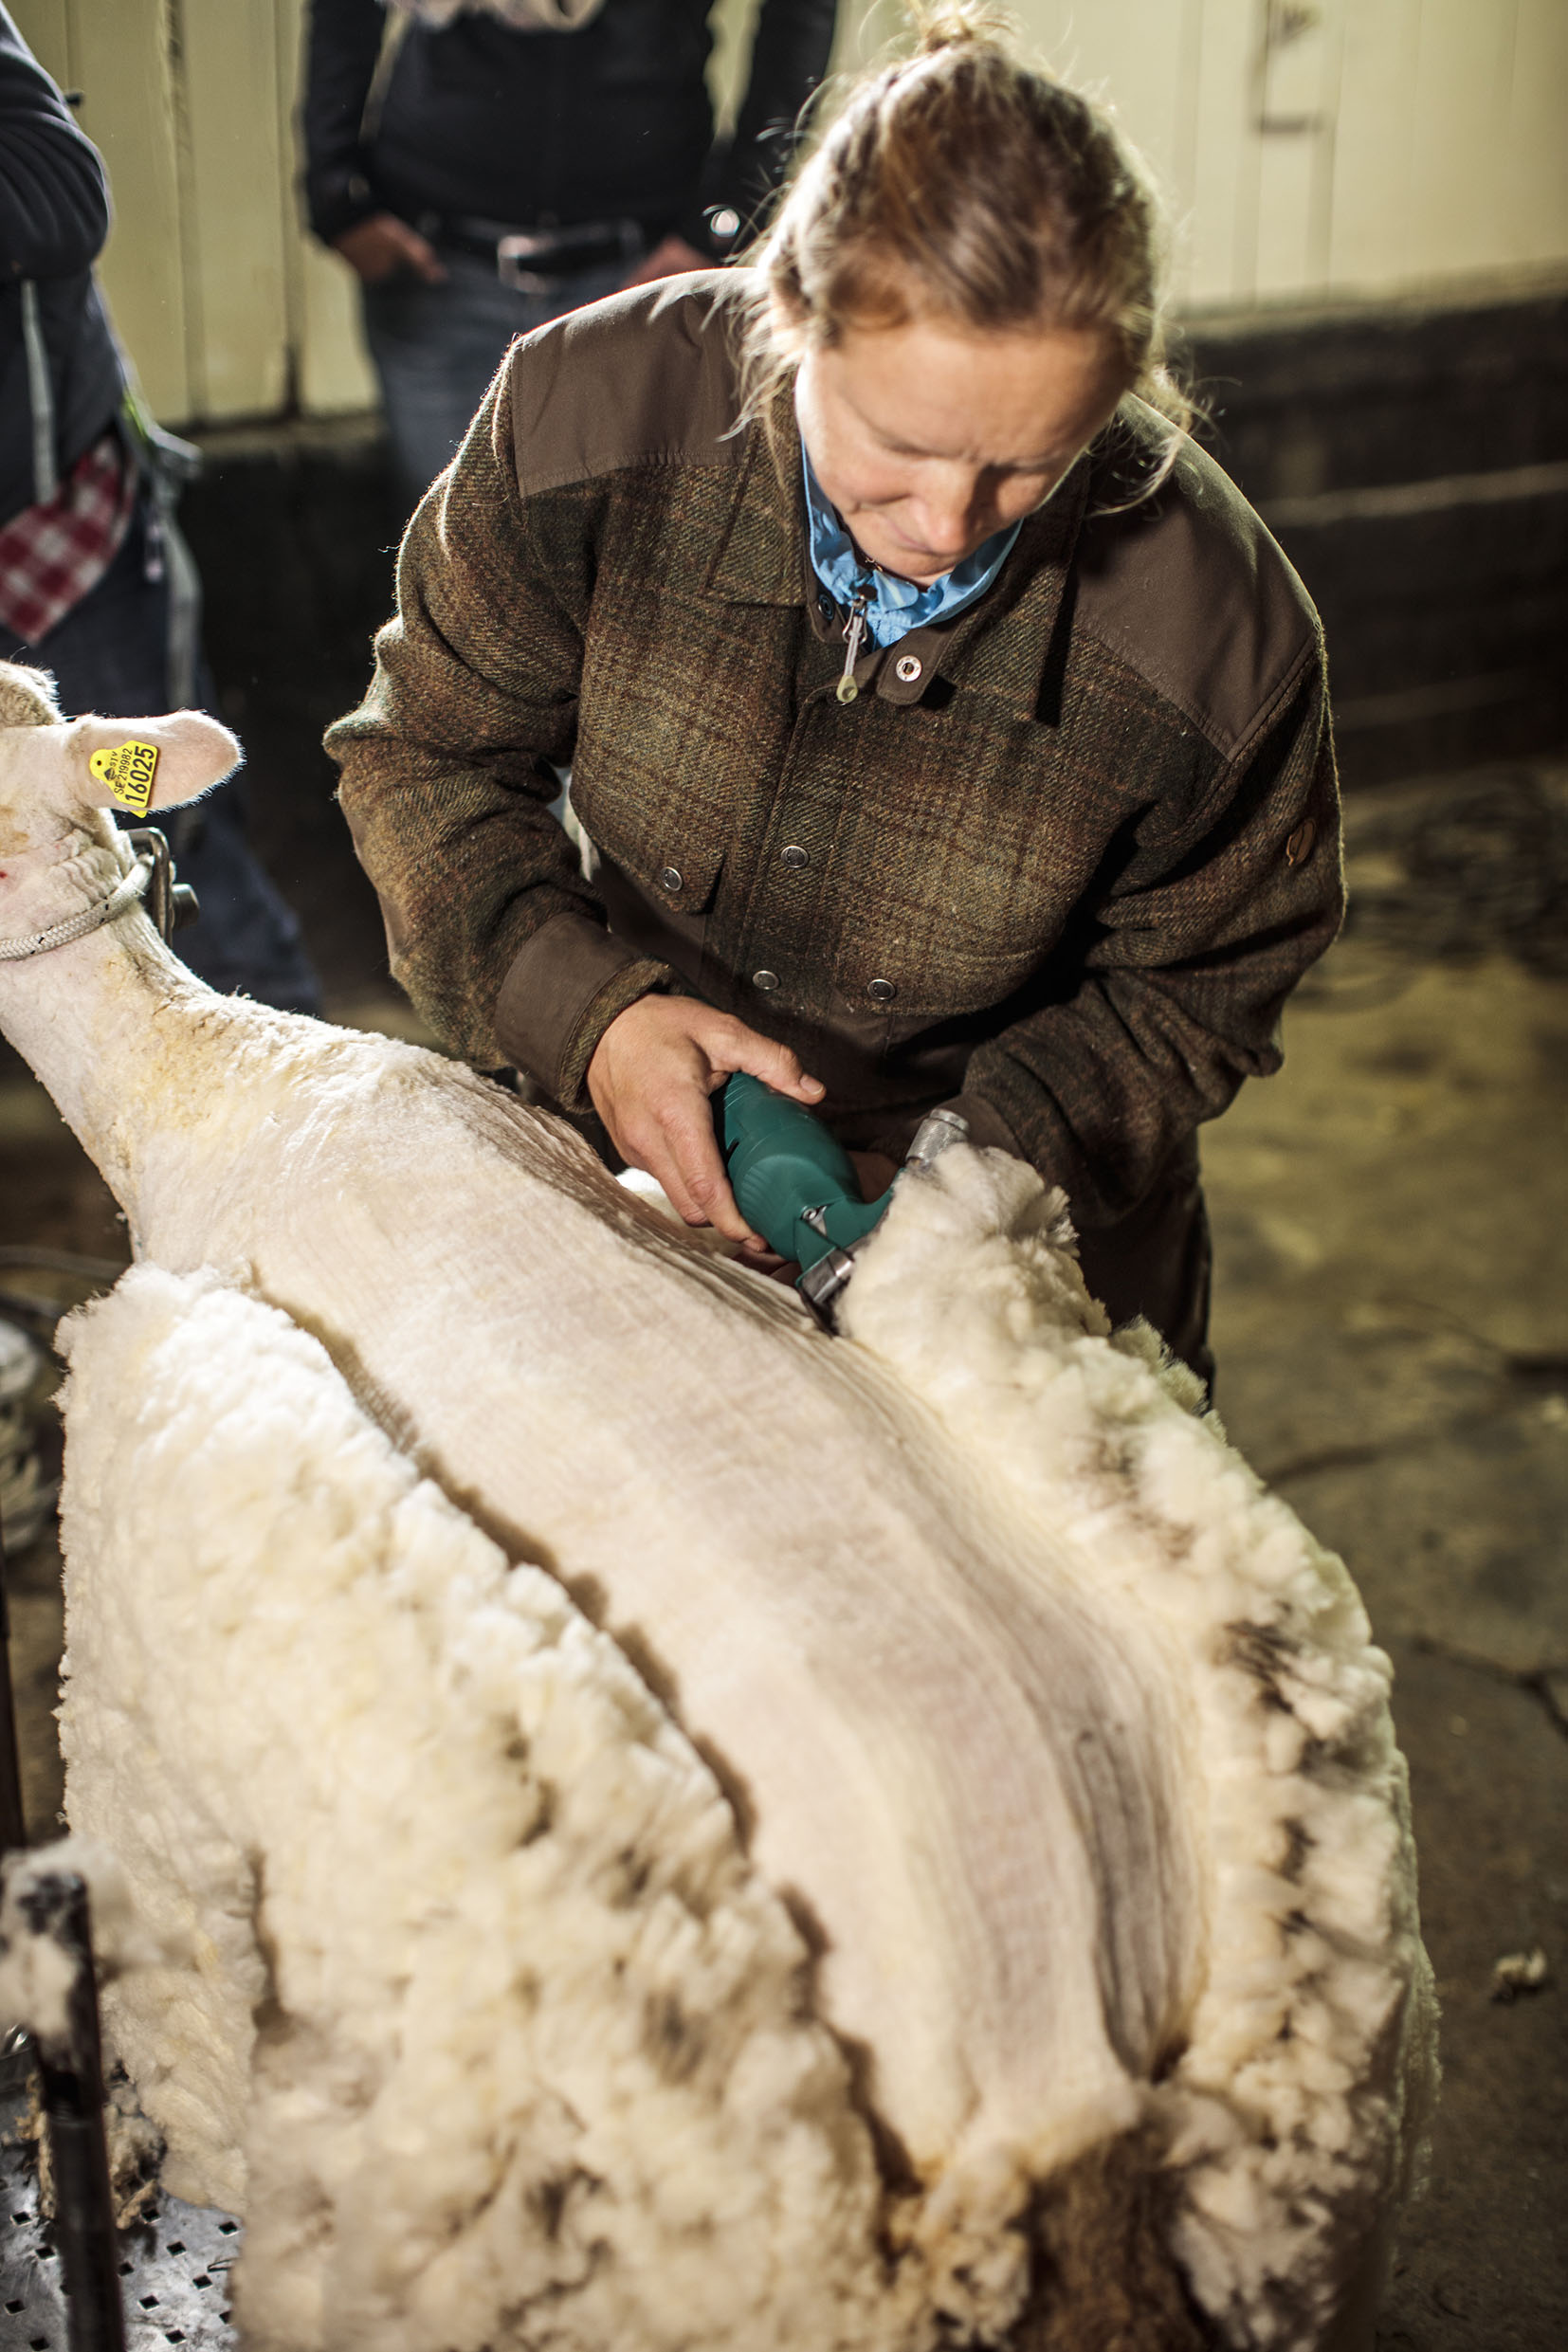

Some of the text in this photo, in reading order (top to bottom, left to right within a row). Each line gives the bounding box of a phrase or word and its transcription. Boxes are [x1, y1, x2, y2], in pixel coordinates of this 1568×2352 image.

[114, 748, 133, 794] SE 219982
[125, 745, 155, 803] 16025
